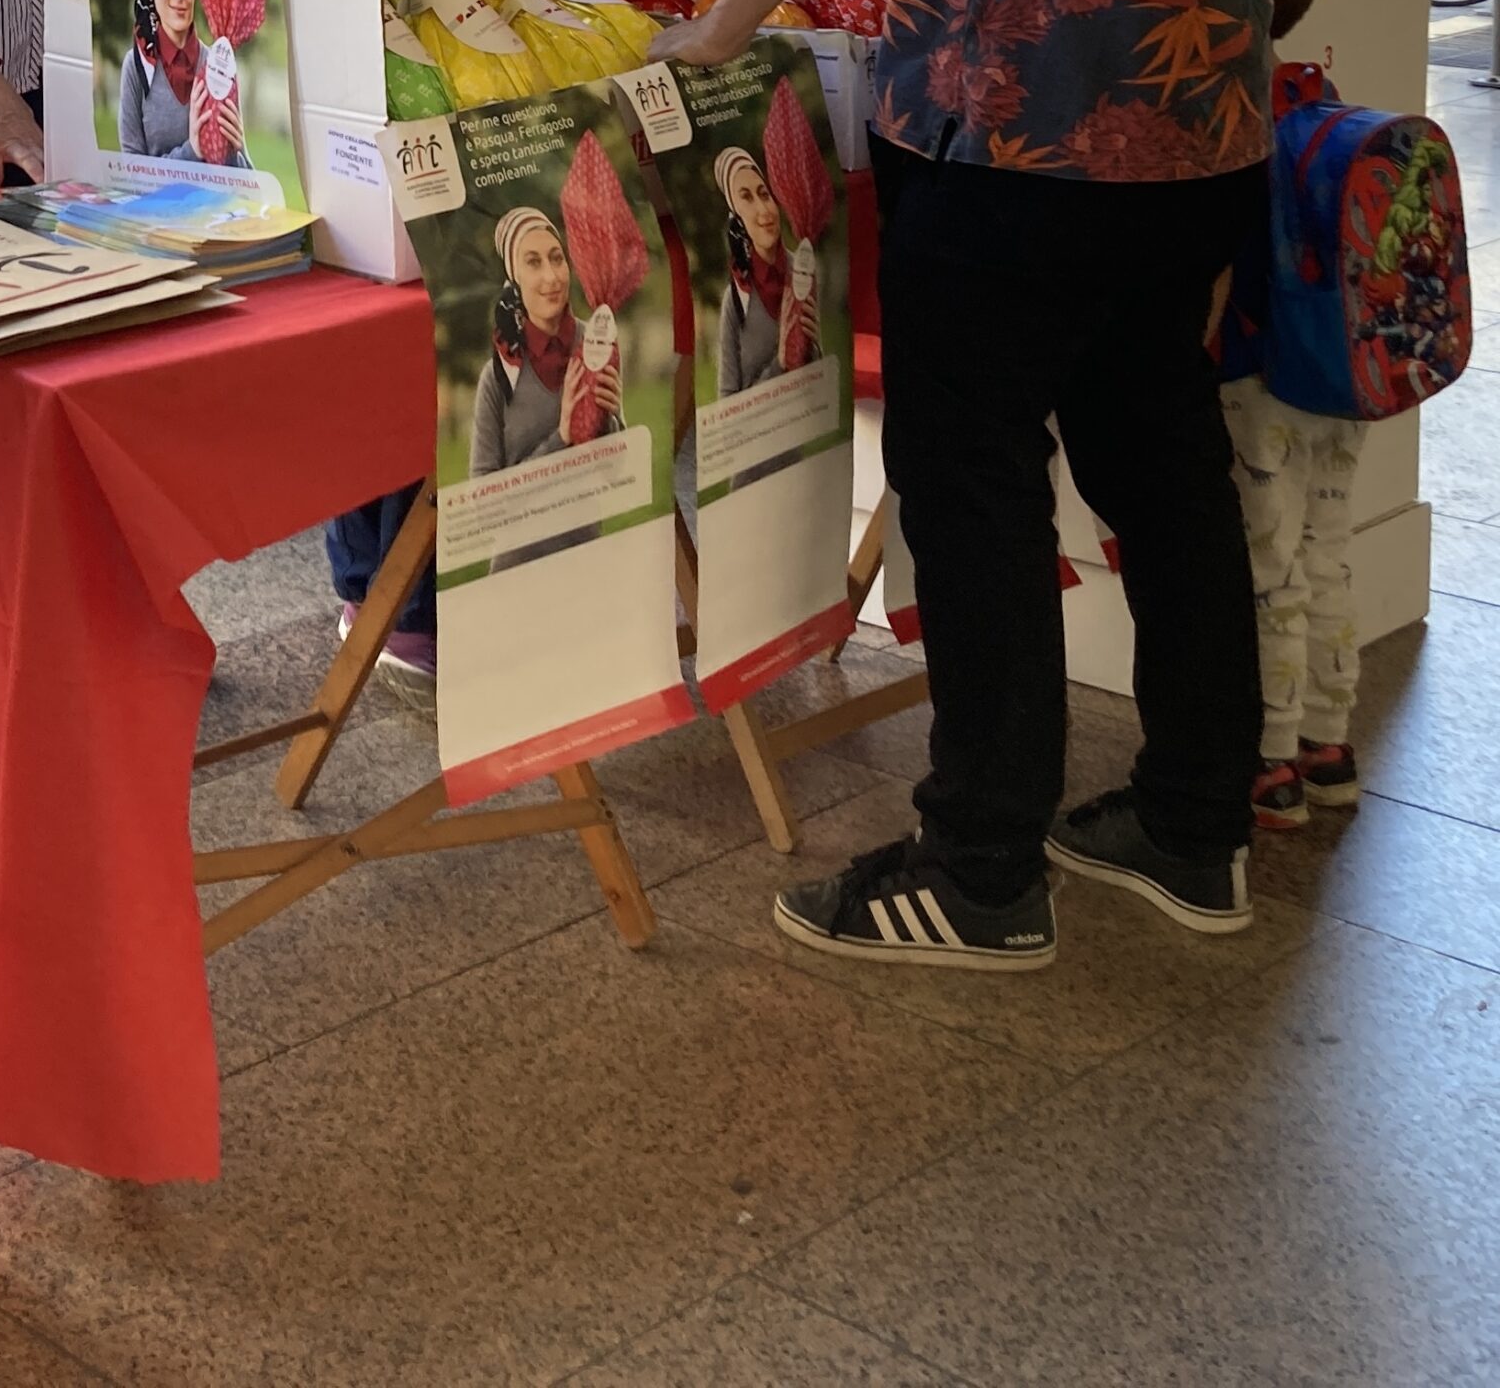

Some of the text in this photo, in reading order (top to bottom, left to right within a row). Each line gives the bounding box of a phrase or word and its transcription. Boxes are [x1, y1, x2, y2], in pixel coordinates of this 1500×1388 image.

[1324, 45, 1332, 69] 3
[677, 66, 692, 78] Per
[720, 64, 772, 85] Ferragosto
[691, 101, 697, 110] e
[460, 103, 557, 134] Per me quest'uovo
[465, 117, 574, 151] è Pasqua, Ferragosto
[336, 149, 372, 167] FONDENTE
[471, 137, 564, 169] e spero tantissimi
[132, 164, 156, 176] APRILE
[158, 169, 166, 177] IN
[167, 169, 190, 181] TUTTE
[191, 173, 201, 181] LE
[202, 174, 227, 185] PIAZZE
[229, 177, 260, 189] D'ITALIA
[475, 163, 540, 188] compleanni.
[479, 480, 510, 497] APRILE
[521, 467, 550, 484] TUTTE
[1005, 933, 1045, 945] adidas
